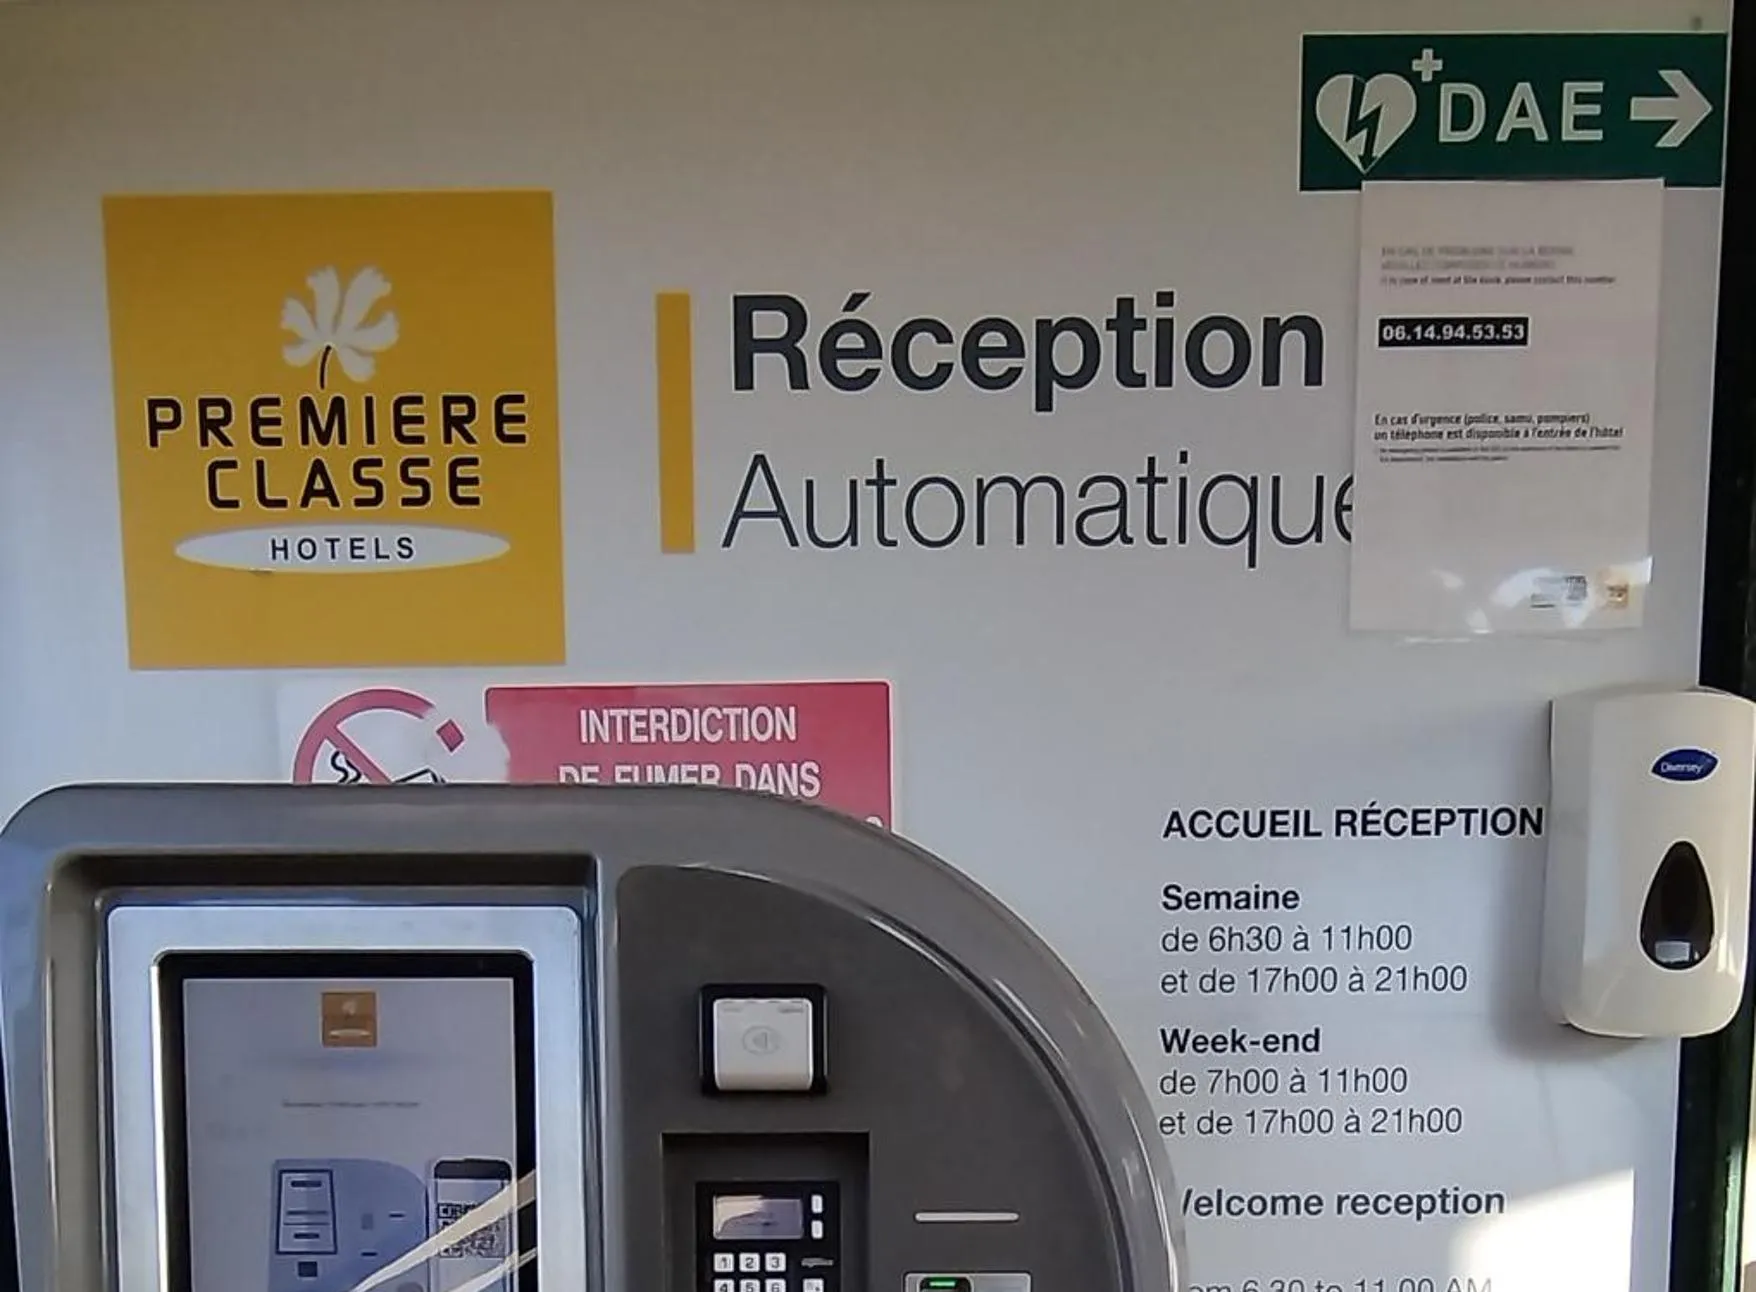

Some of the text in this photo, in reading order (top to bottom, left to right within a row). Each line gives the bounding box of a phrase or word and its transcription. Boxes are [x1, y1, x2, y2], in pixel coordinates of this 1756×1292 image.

[1439, 81, 1604, 143] DAE
[1382, 324, 1525, 341] 06.14.94.53.53
[732, 292, 1323, 413] Réception
[146, 394, 527, 448] PREMIERE
[207, 457, 481, 510] CLASSE
[271, 536, 415, 560] HOTELS
[579, 706, 796, 744] INTERDICTION
[735, 761, 820, 797] DANS
[1162, 800, 1544, 839] ACCUEIL RÉCEPTION
[1162, 884, 1300, 911] Semaine
[1161, 924, 1412, 952] de 6h30 à 11h00
[1161, 965, 1467, 994] et de 17h00 à 21h00
[1160, 1027, 1320, 1054] Week-end
[1159, 1067, 1408, 1095] de 7h00 à 11h00
[1159, 1107, 1462, 1136] et de 17h00 à 21h00
[1182, 1186, 1505, 1222] elcome reception
